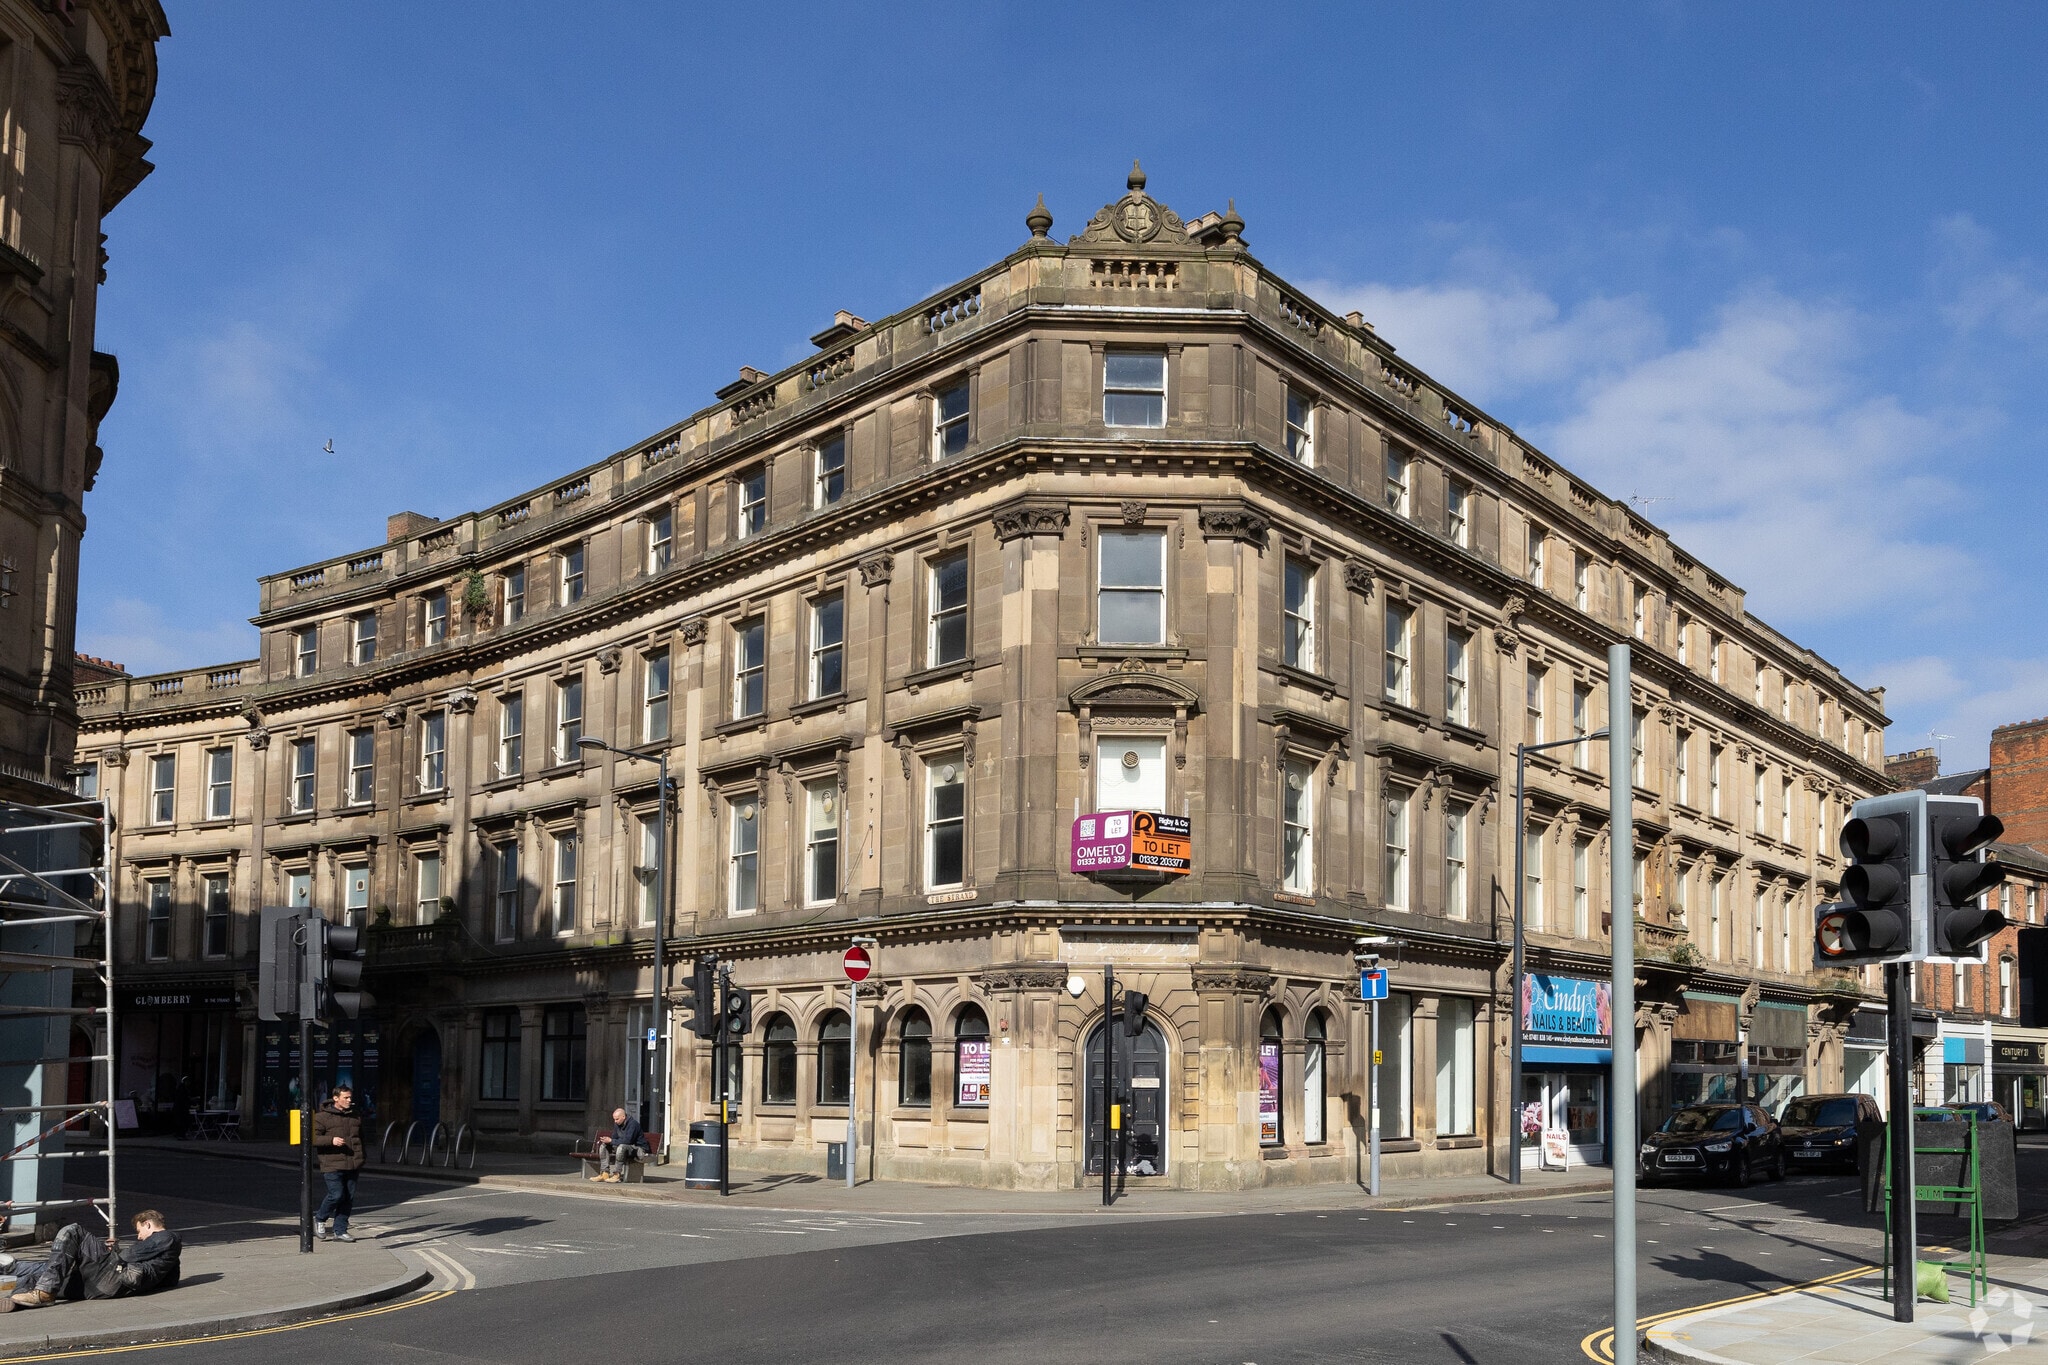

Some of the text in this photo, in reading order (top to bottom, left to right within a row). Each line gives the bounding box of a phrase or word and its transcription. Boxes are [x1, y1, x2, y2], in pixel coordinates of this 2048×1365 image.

[1158, 817, 1174, 827] Rigby
[1180, 819, 1189, 827] Co
[1076, 843, 1126, 859] OMEETO
[1143, 840, 1181, 855] TO LET
[1076, 855, 1126, 866] 01332 840 328
[1139, 855, 1184, 868] 01332 203377
[931, 891, 974, 904] THE STRAND
[1544, 982, 1587, 1026] Cindy
[1532, 1013, 1596, 1033] NAILS & BEAUTY
[962, 1043, 990, 1055] TO LE
[1261, 1045, 1277, 1056] LET
[2001, 1047, 2029, 1057] CENTURY 21
[1546, 1133, 1567, 1141] NAILS
